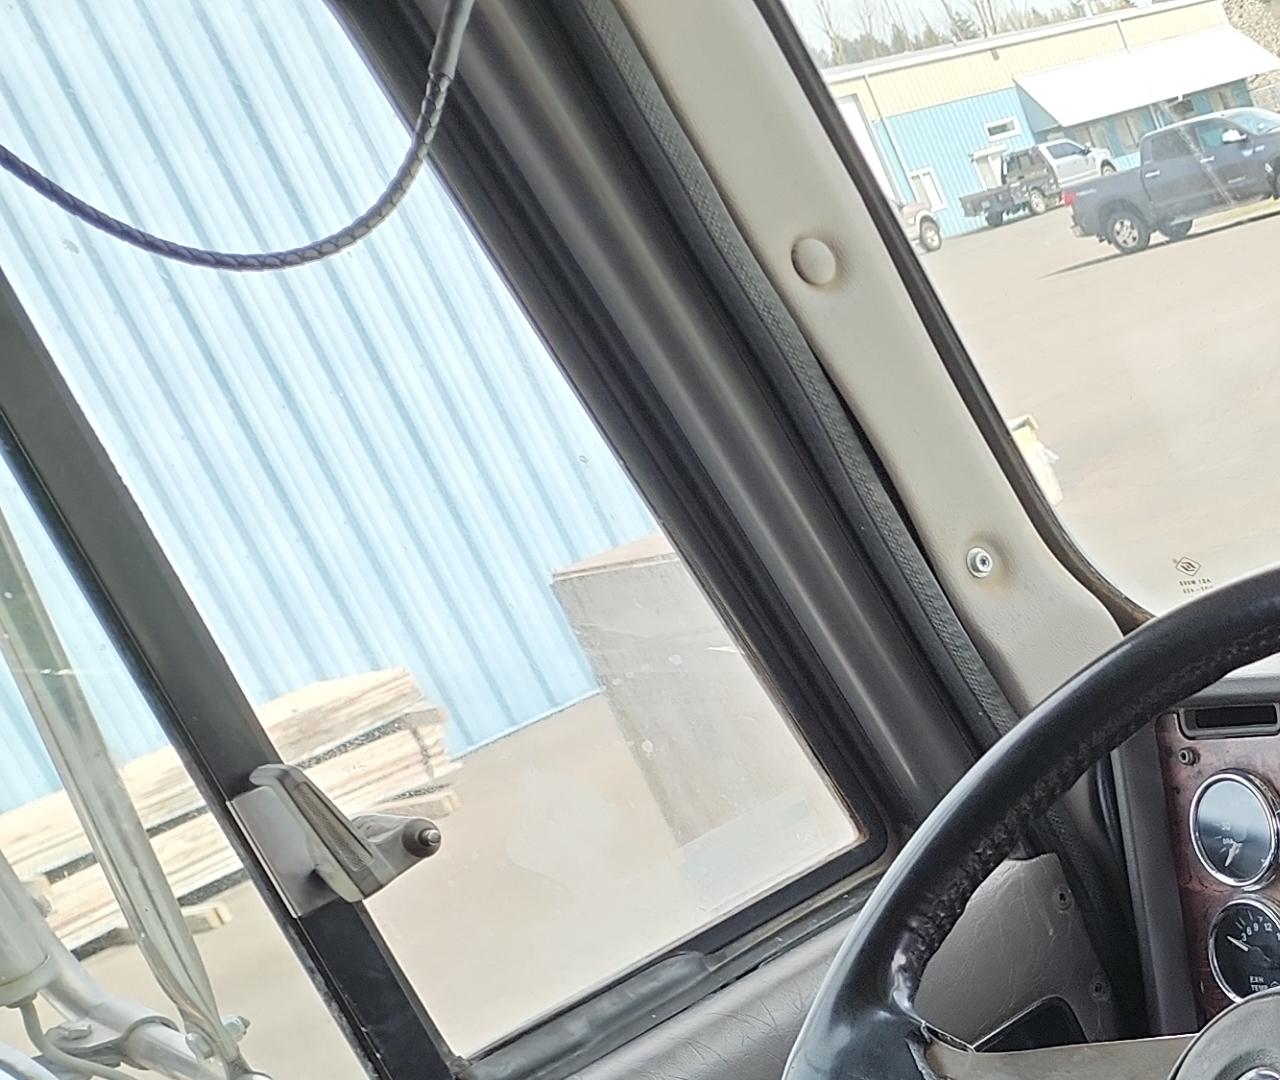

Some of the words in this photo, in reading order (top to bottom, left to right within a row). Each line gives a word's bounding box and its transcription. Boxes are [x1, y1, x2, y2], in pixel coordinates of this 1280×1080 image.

[1253, 922, 1259, 931] 9
[1264, 922, 1273, 931] 12
[1240, 932, 1247, 941] 3
